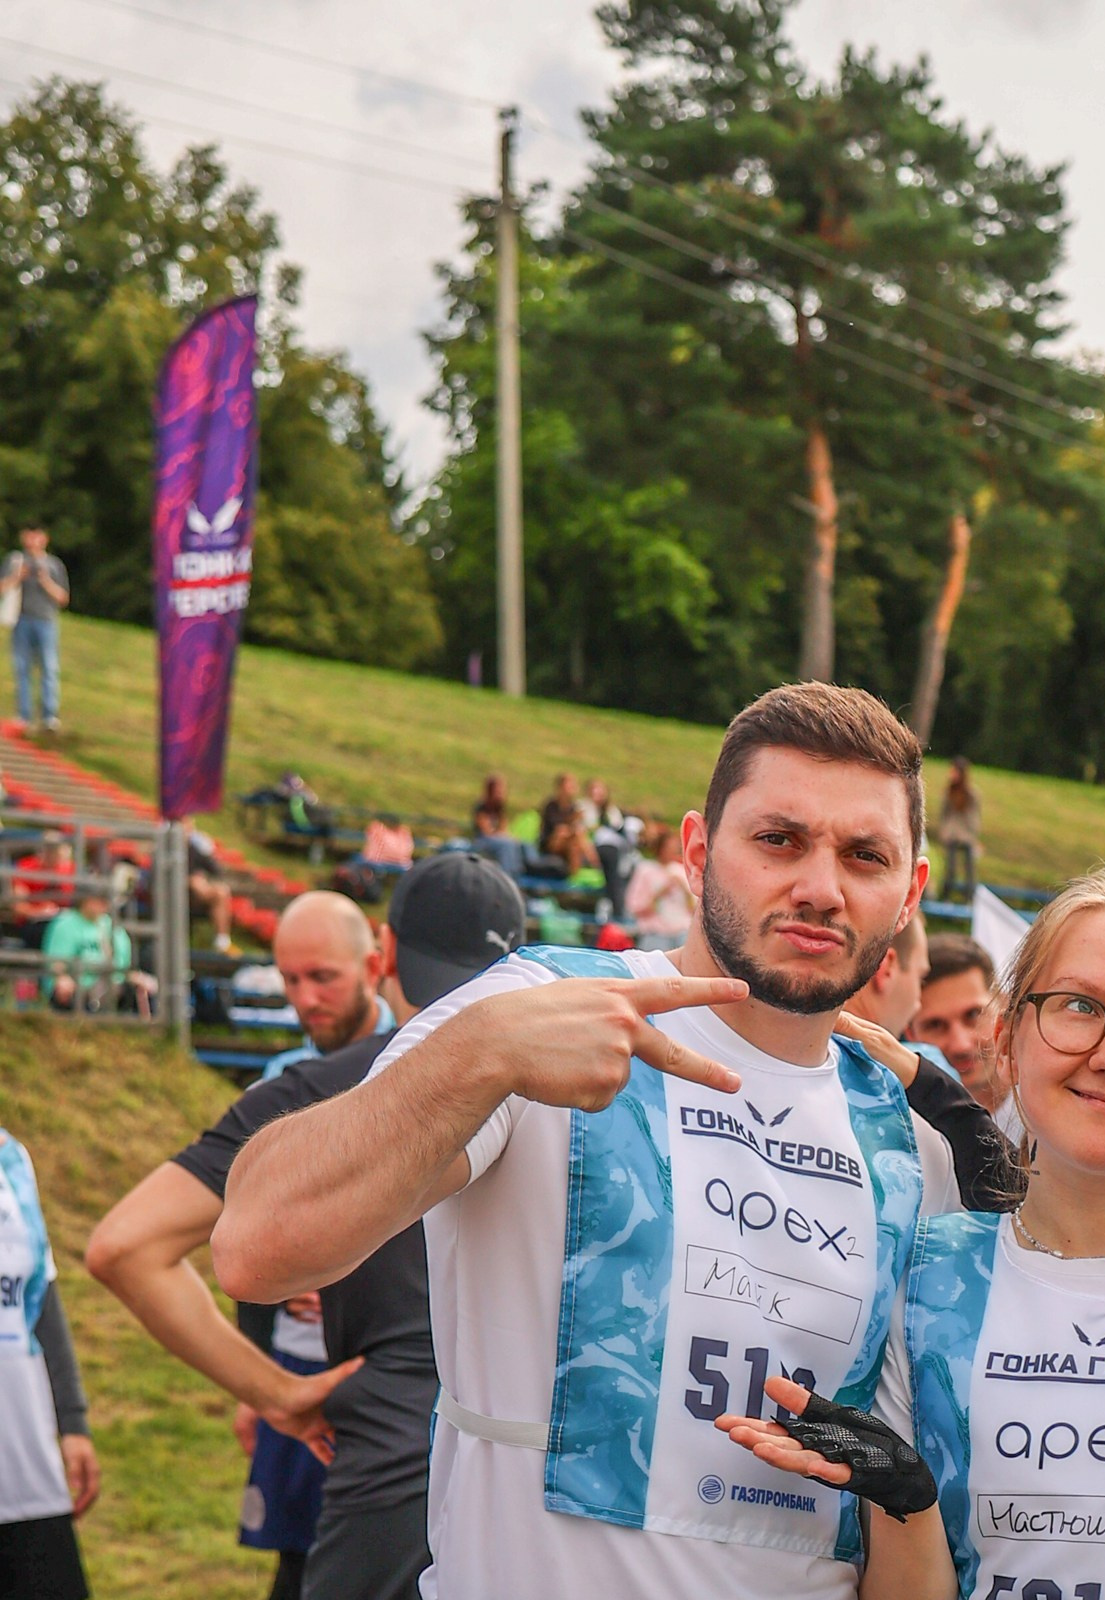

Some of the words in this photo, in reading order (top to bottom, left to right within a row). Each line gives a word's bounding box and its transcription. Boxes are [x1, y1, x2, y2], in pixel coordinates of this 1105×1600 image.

[680, 1106, 760, 1150] ГОНКА
[765, 1138, 862, 1179] ГЕРОЕВ
[705, 1178, 848, 1261] apex
[986, 1352, 1078, 1374] ГОНКА
[731, 1485, 816, 1513] ГАЗПРОМБАНК
